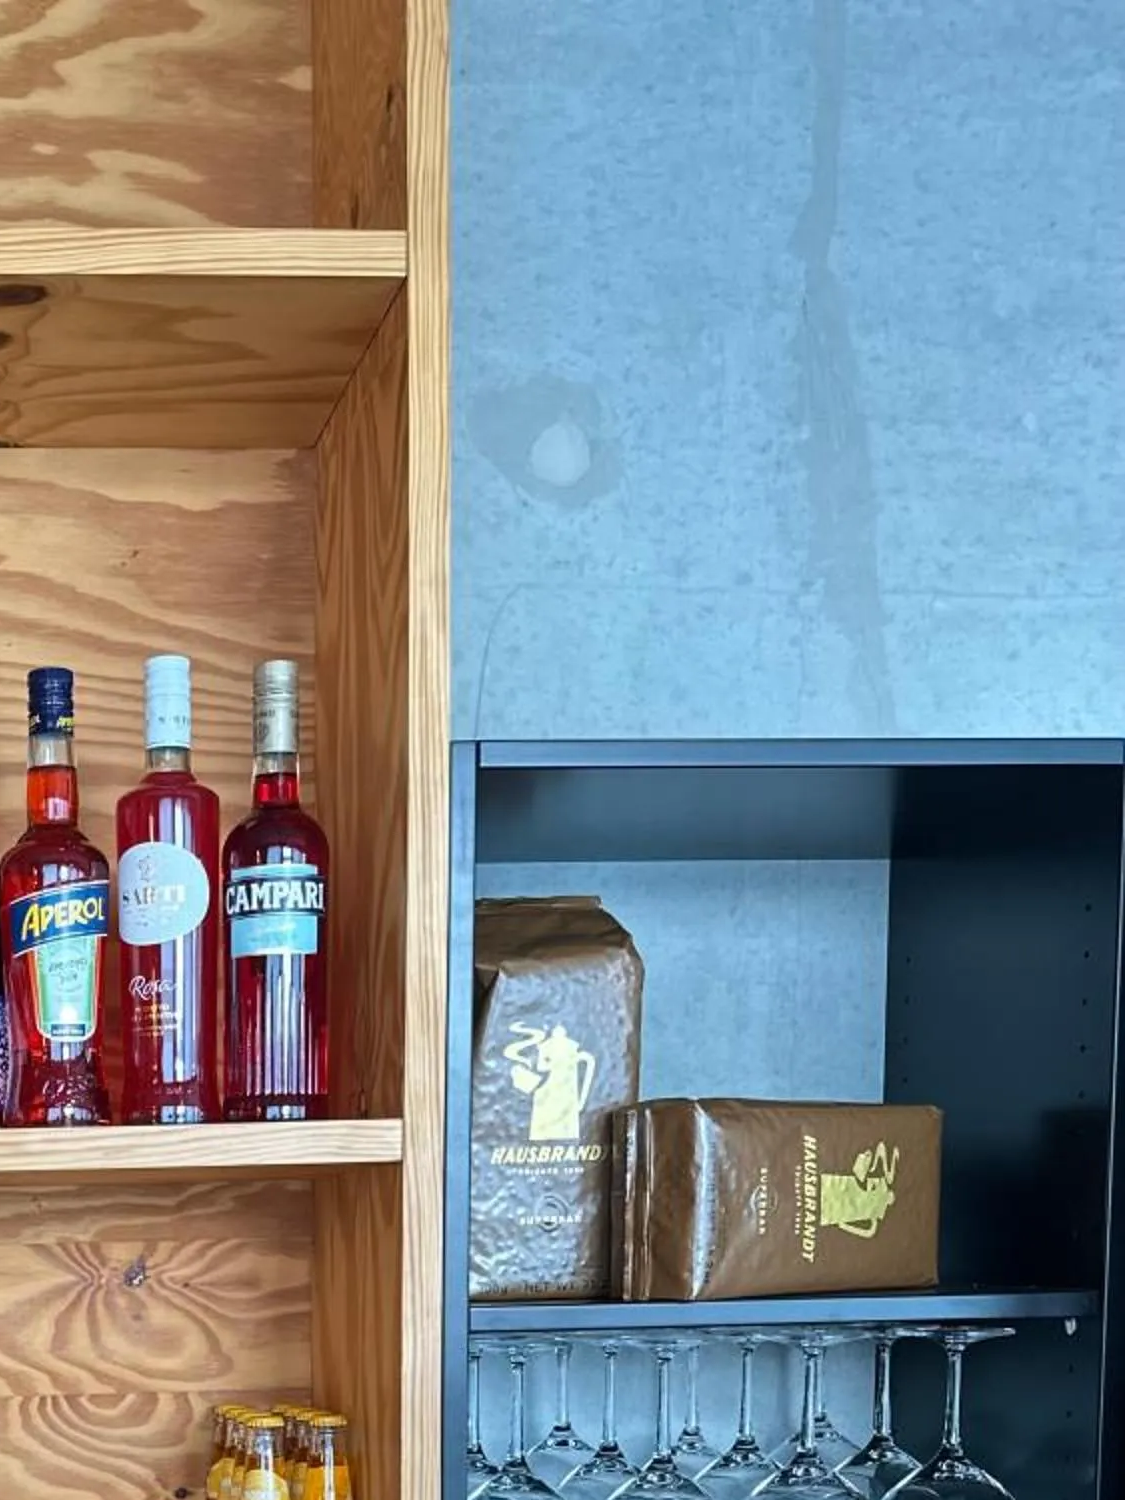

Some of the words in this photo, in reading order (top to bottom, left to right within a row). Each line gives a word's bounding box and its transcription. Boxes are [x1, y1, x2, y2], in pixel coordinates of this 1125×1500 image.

[226, 880, 324, 915] CAMPARI
[20, 897, 106, 942] APEROL
[490, 1145, 603, 1164] HAUSBRAND
[802, 1135, 817, 1263] HAUSBRANDT
